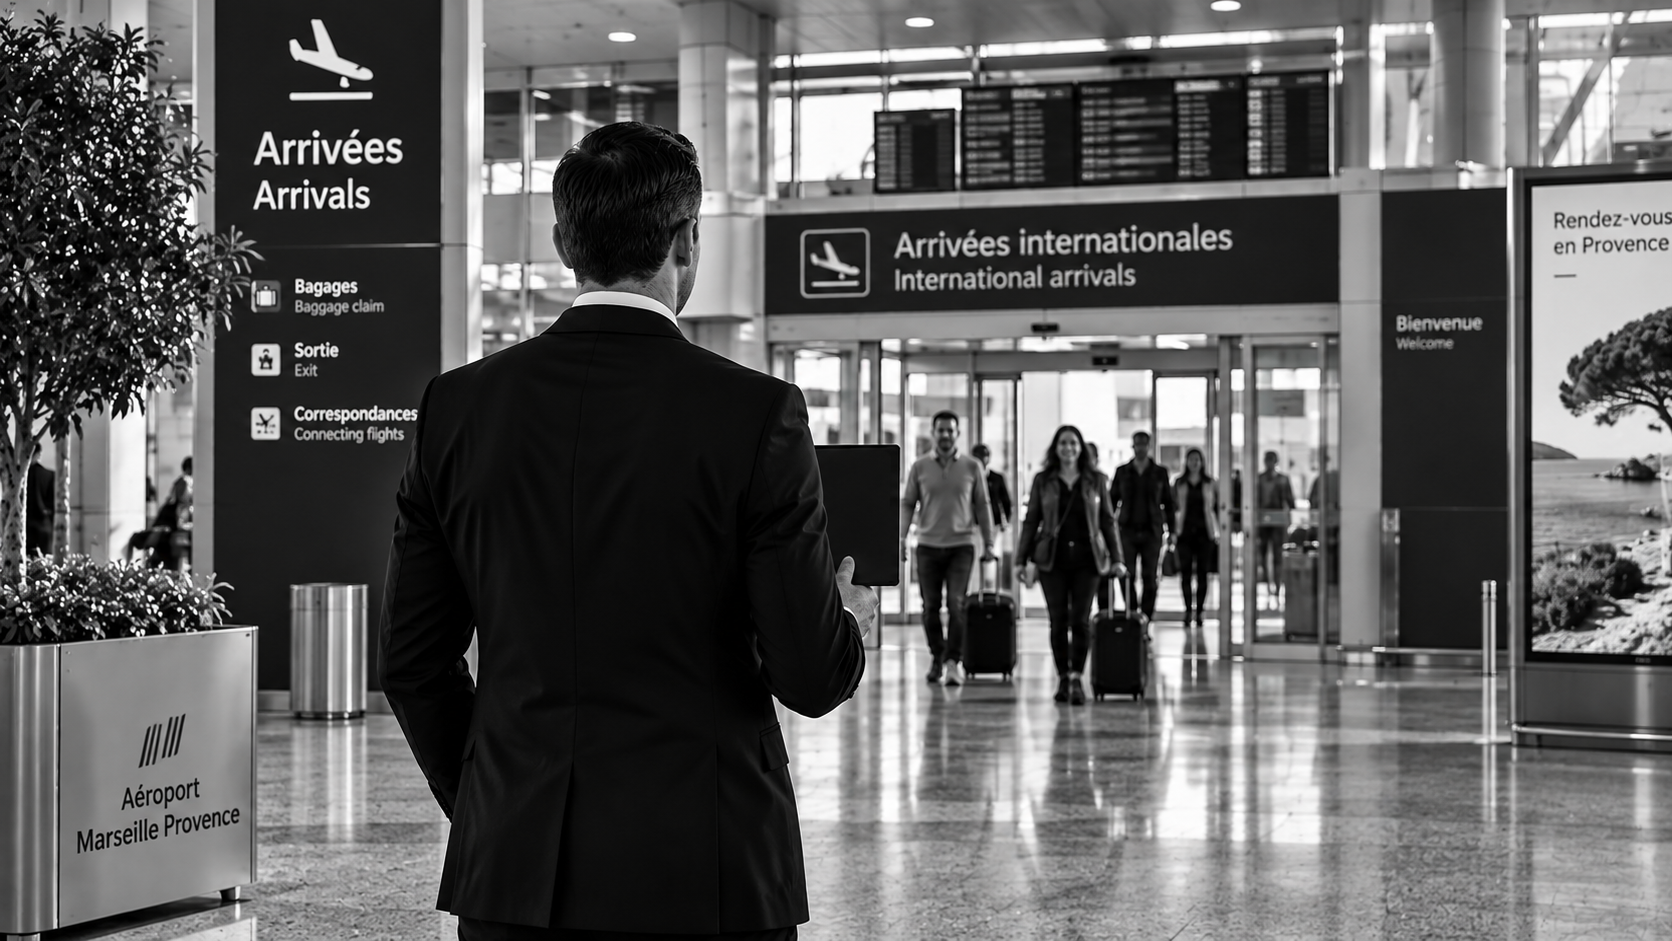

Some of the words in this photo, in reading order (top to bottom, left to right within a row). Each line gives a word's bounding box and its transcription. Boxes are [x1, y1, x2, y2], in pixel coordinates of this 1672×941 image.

[253, 128, 404, 166] Arrivées
[253, 177, 371, 210] Arrivals
[1554, 209, 1672, 229] Rendez-vous
[894, 229, 1011, 259] Arrivées
[1019, 222, 1233, 256] internationales
[1553, 240, 1576, 255] en
[1582, 236, 1670, 254] Provence
[894, 264, 1043, 292] International
[1049, 262, 1137, 288] arrivals
[294, 278, 358, 298] Bagages
[294, 299, 349, 316] Baggage
[351, 299, 385, 313] claim
[1396, 314, 1483, 332] Bienvenue
[294, 341, 339, 358] Sortie
[1395, 336, 1454, 350] Welcome
[294, 363, 318, 377] Exit
[293, 405, 418, 425] Correspondances
[293, 427, 364, 444] Connecting
[121, 777, 200, 811] Aéroport
[76, 818, 159, 854] Marseille
[164, 807, 240, 837] Provence
